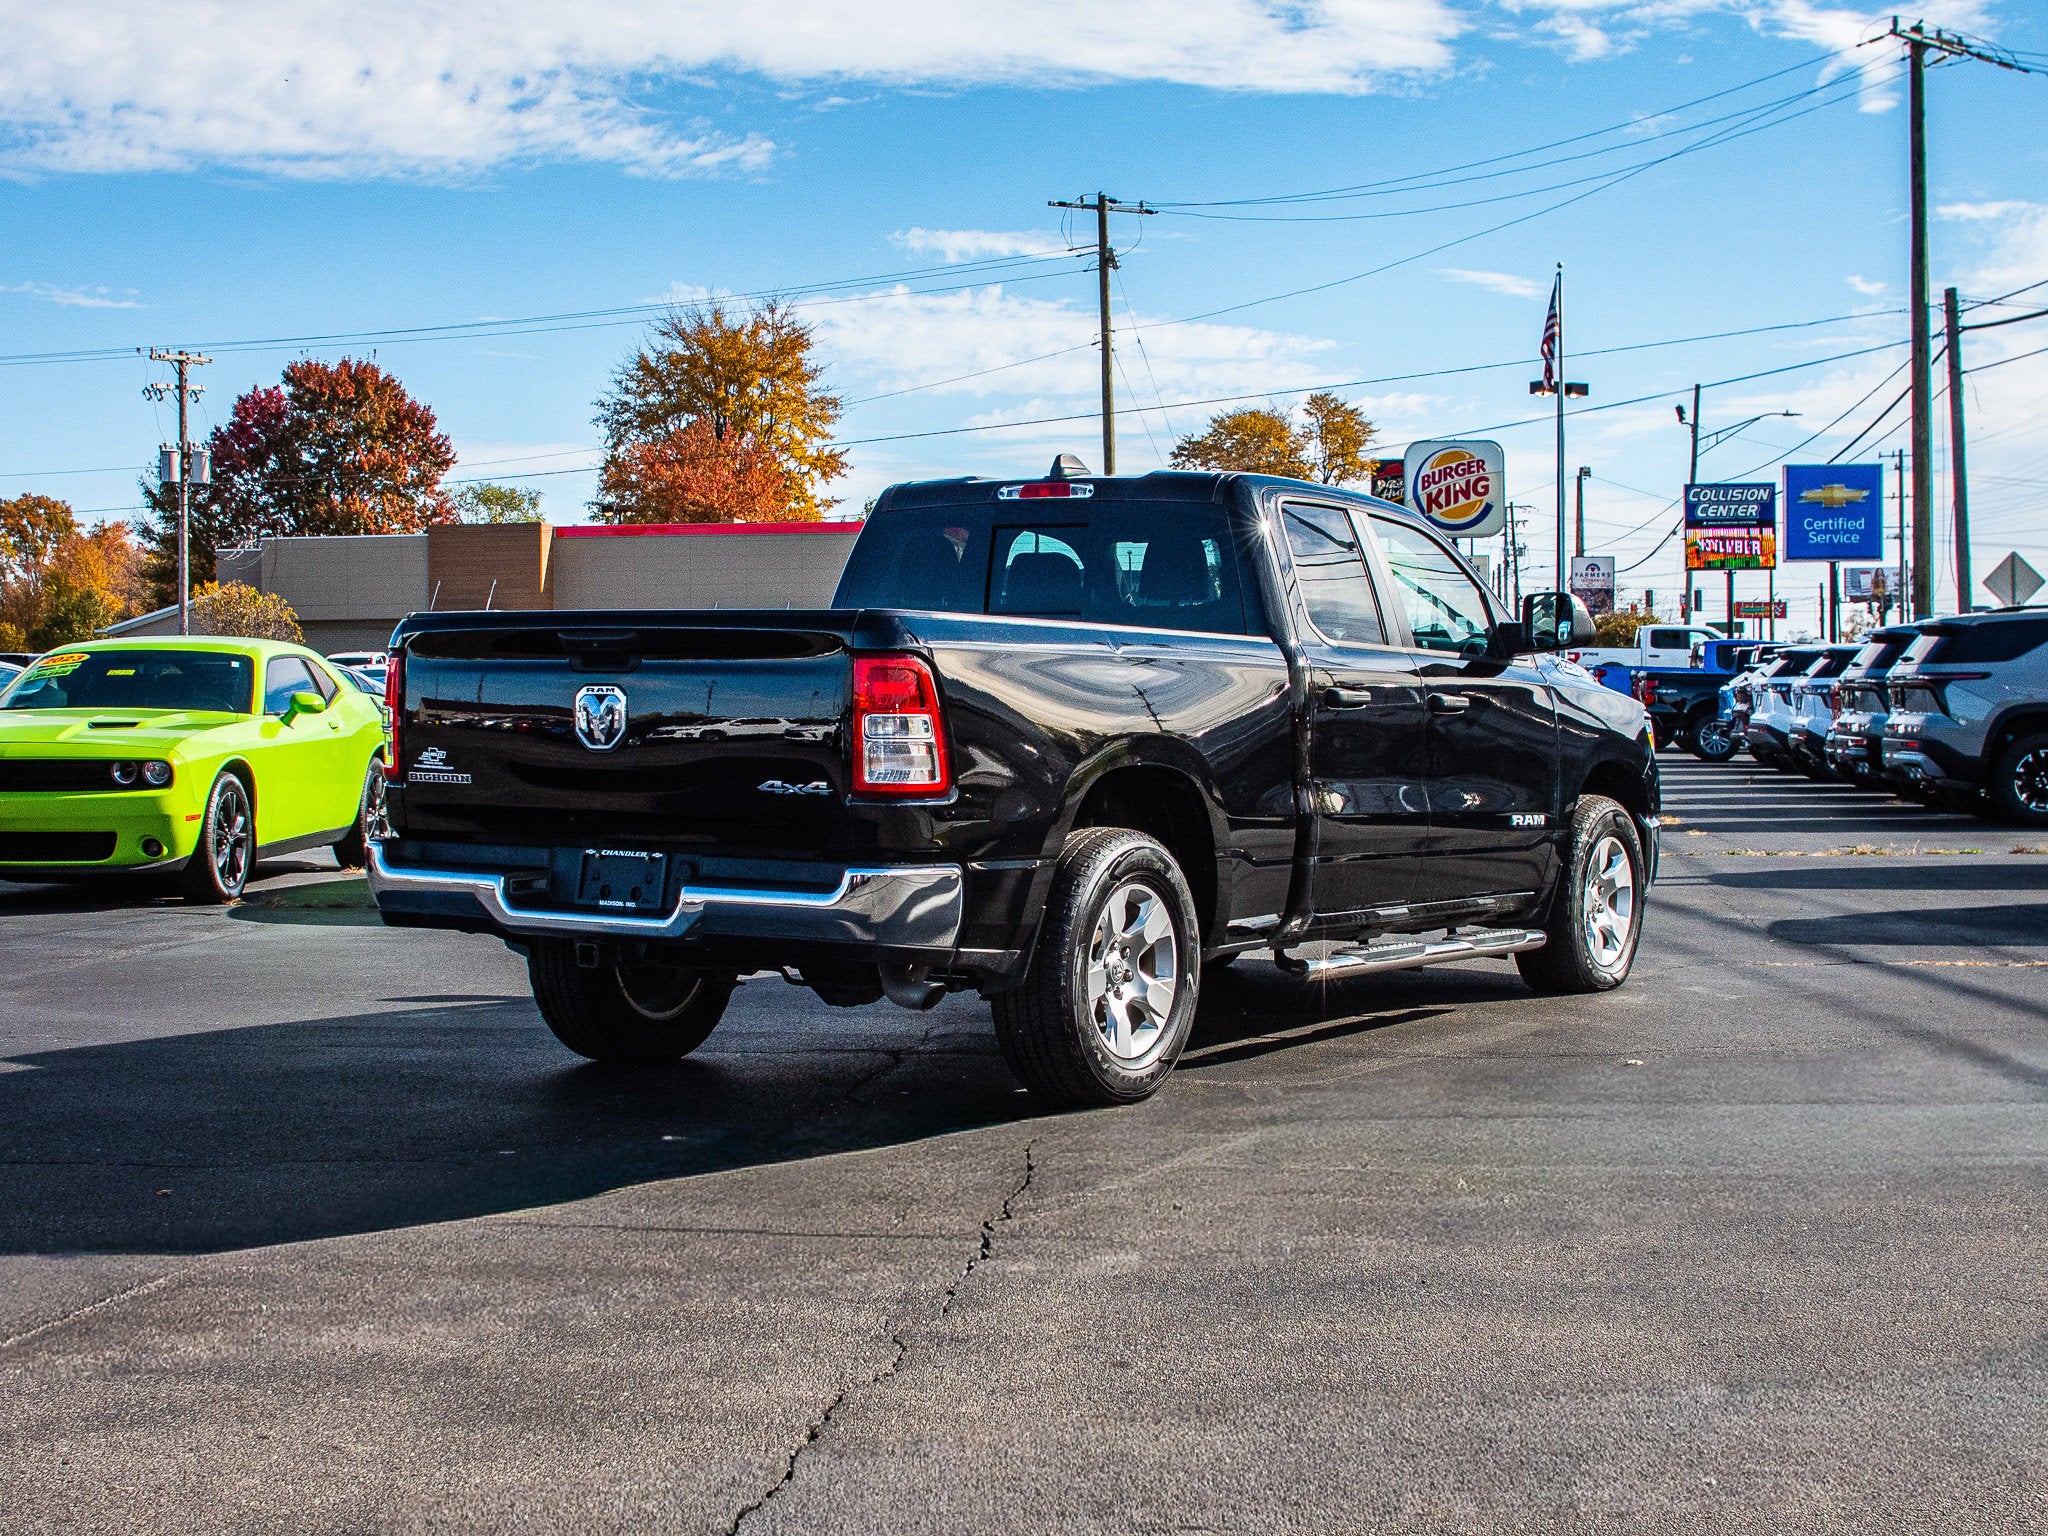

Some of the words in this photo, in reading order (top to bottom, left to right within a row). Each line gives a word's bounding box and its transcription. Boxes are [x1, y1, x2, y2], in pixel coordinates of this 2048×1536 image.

[1421, 459, 1486, 491] BURGER
[1426, 476, 1490, 514] KING
[1689, 488, 1769, 502] COLLISION
[1697, 504, 1759, 517] CENTER
[1804, 517, 1865, 530] Certified
[1808, 531, 1860, 544] Service
[409, 772, 471, 783] BIGHORN
[1511, 814, 1546, 826] RAM
[601, 849, 648, 858] CHANDLER
